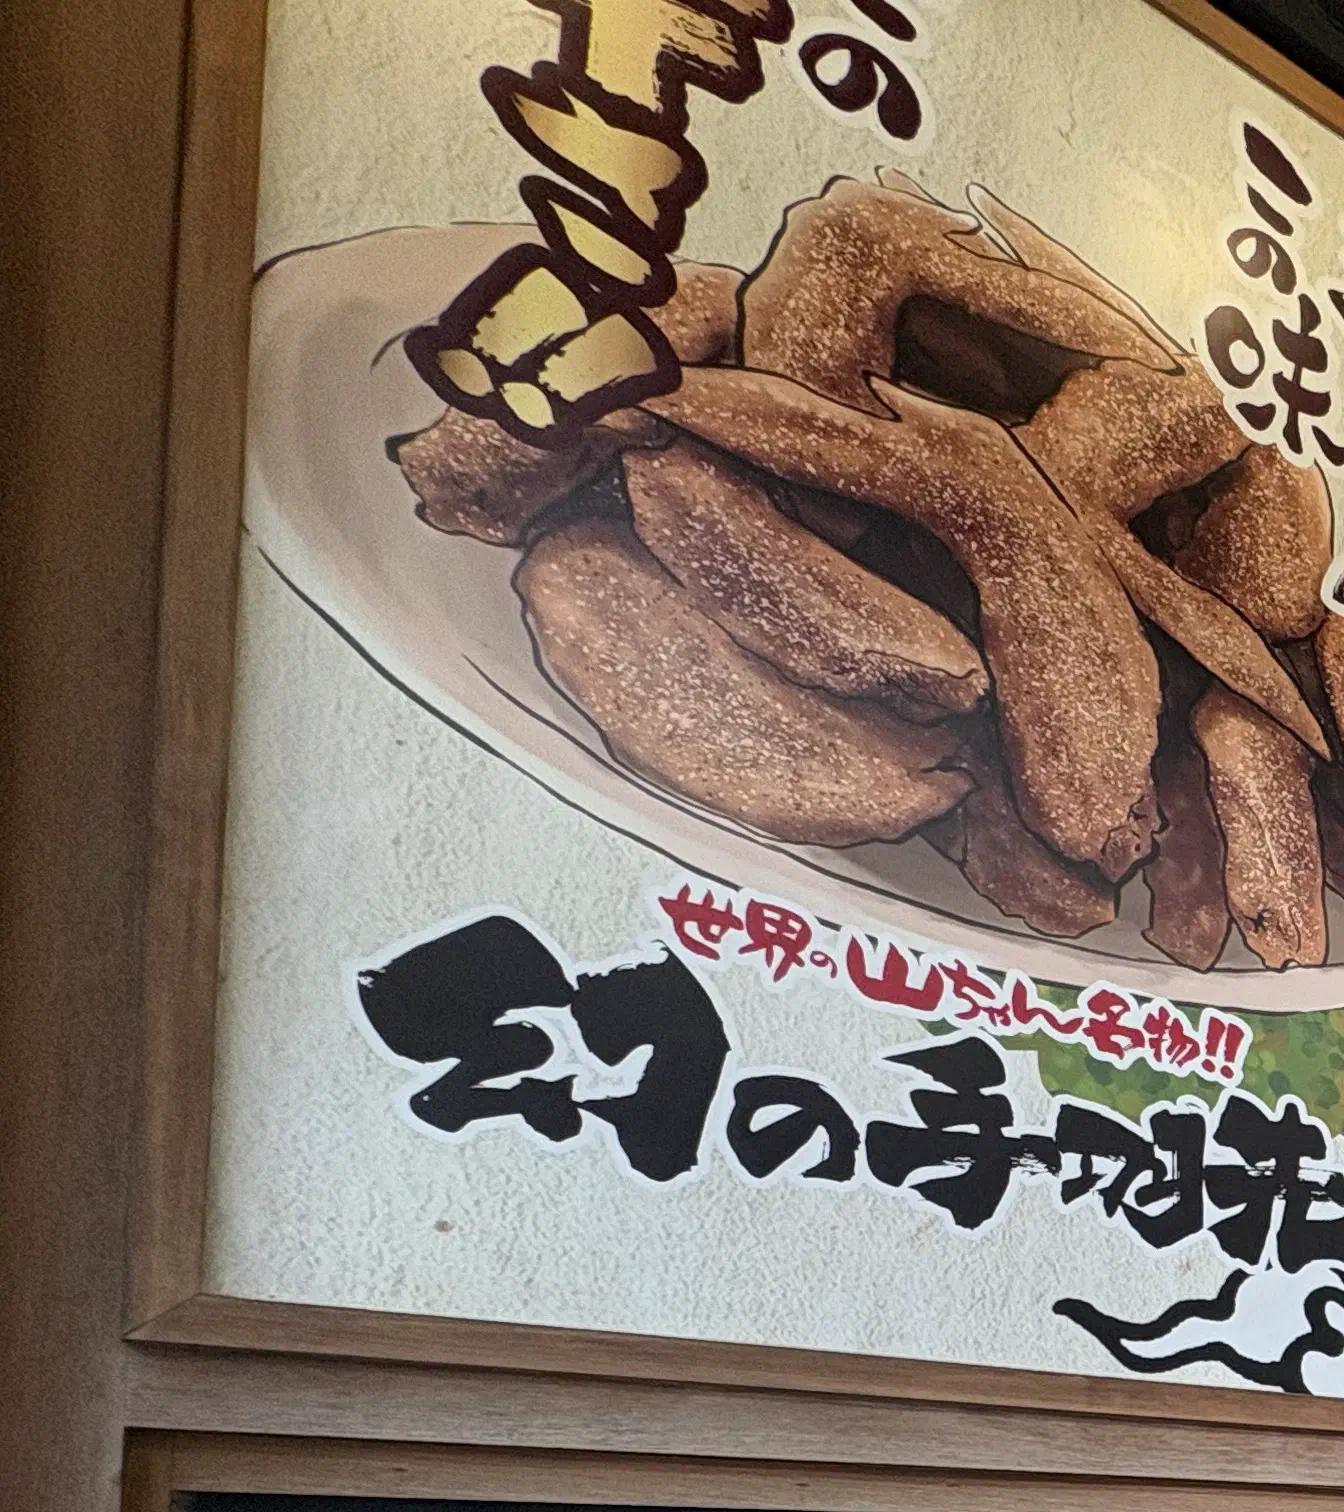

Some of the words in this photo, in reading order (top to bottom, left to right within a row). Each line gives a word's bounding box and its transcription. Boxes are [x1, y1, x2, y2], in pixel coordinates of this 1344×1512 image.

[659, 884, 1246, 1080] 世界の山ちゃん名物!!
